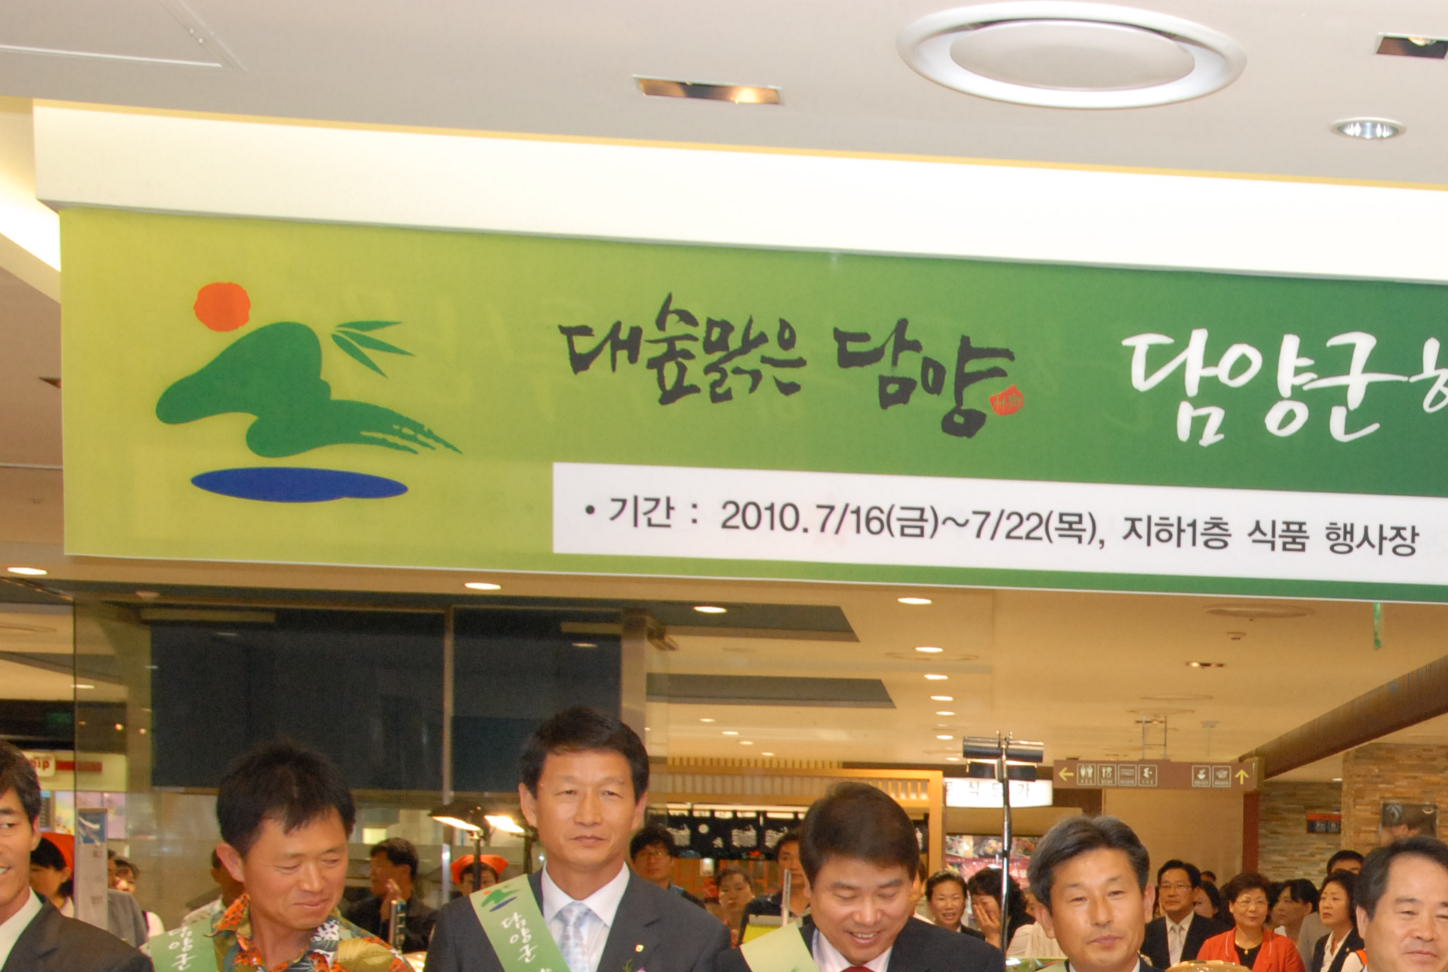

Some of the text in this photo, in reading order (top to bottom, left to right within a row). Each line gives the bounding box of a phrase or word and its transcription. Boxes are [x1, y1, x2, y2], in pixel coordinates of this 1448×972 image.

[558, 293, 1015, 439] 대숲맑은 담양
[1122, 513, 1232, 550] 지하1층
[1247, 518, 1310, 553] 식품
[1324, 521, 1419, 558] 행사장
[501, 912, 537, 963] 담양군
